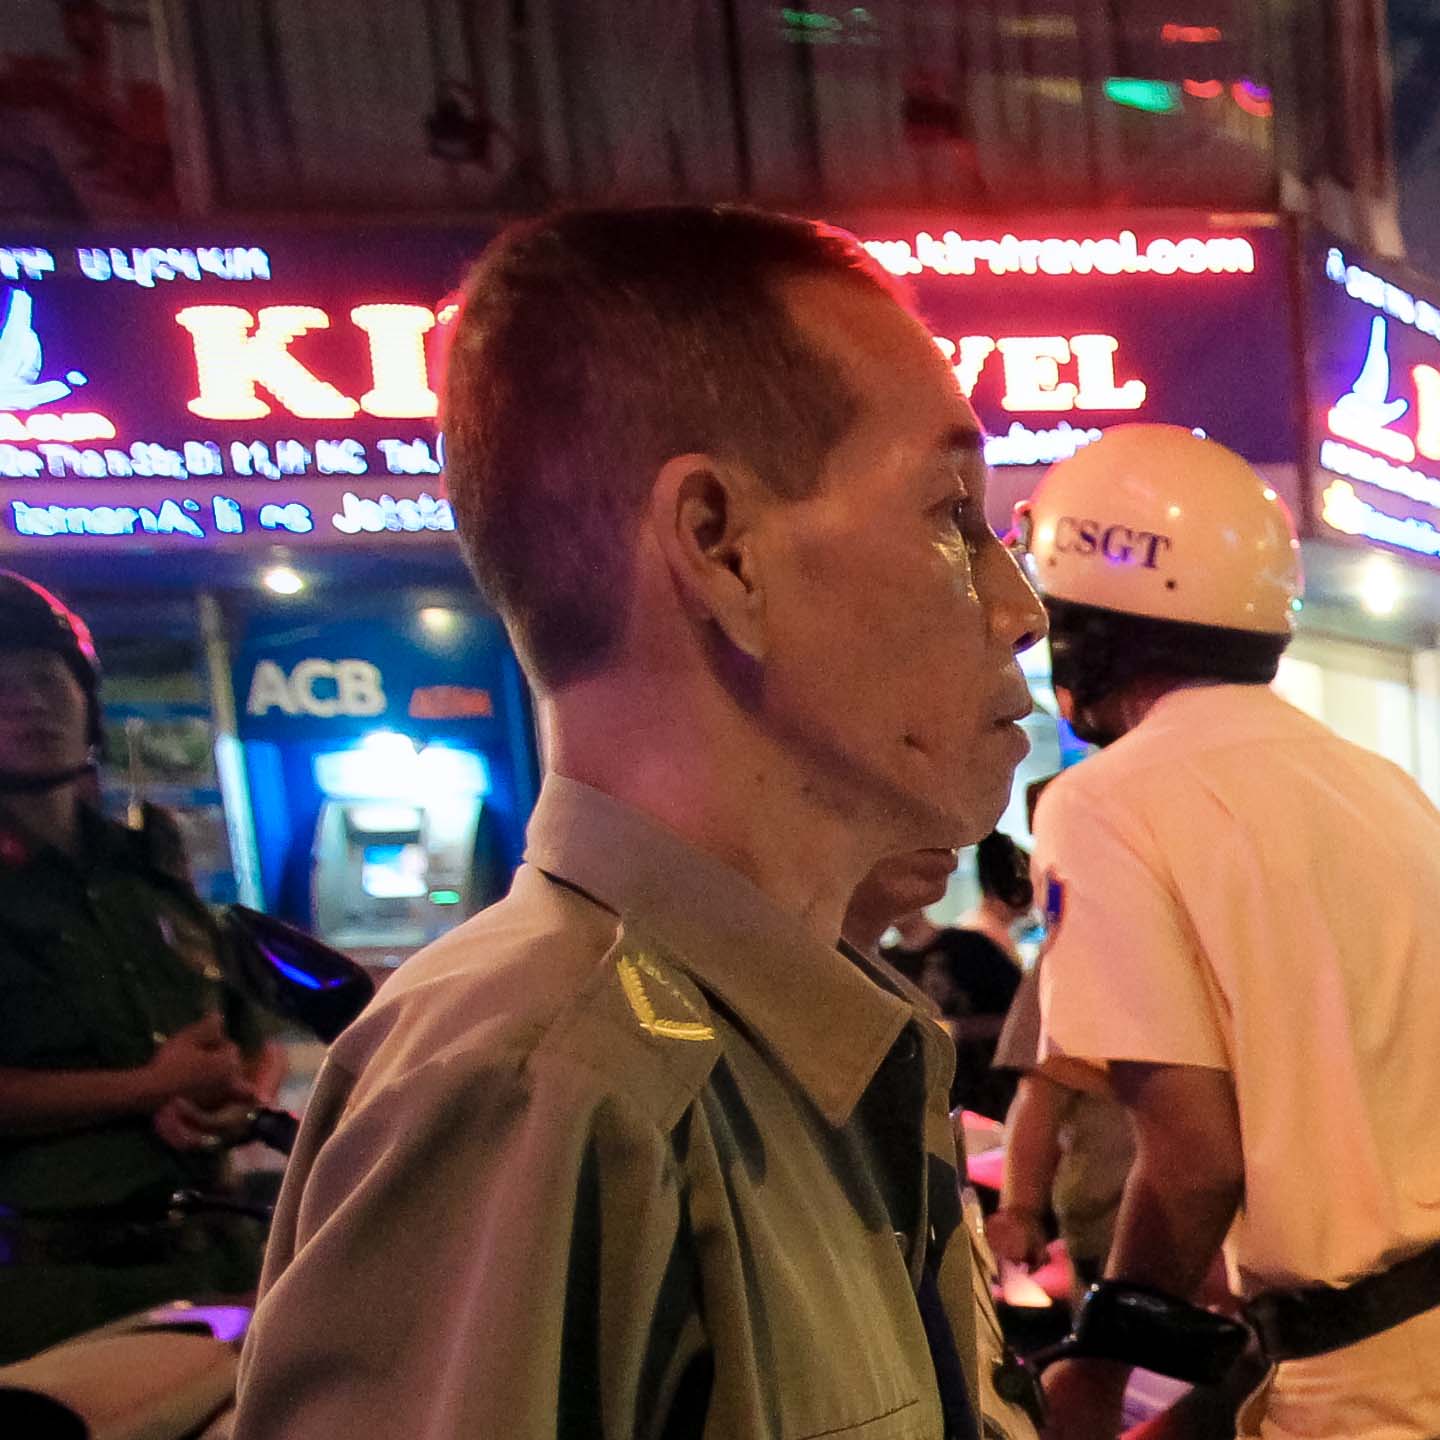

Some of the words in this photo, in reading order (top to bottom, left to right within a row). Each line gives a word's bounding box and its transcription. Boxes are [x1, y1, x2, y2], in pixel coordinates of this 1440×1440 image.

[175, 304, 458, 420] KI
[930, 335, 1147, 411] VEL
[1056, 516, 1171, 570] CSGT
[246, 658, 387, 718] ACB
